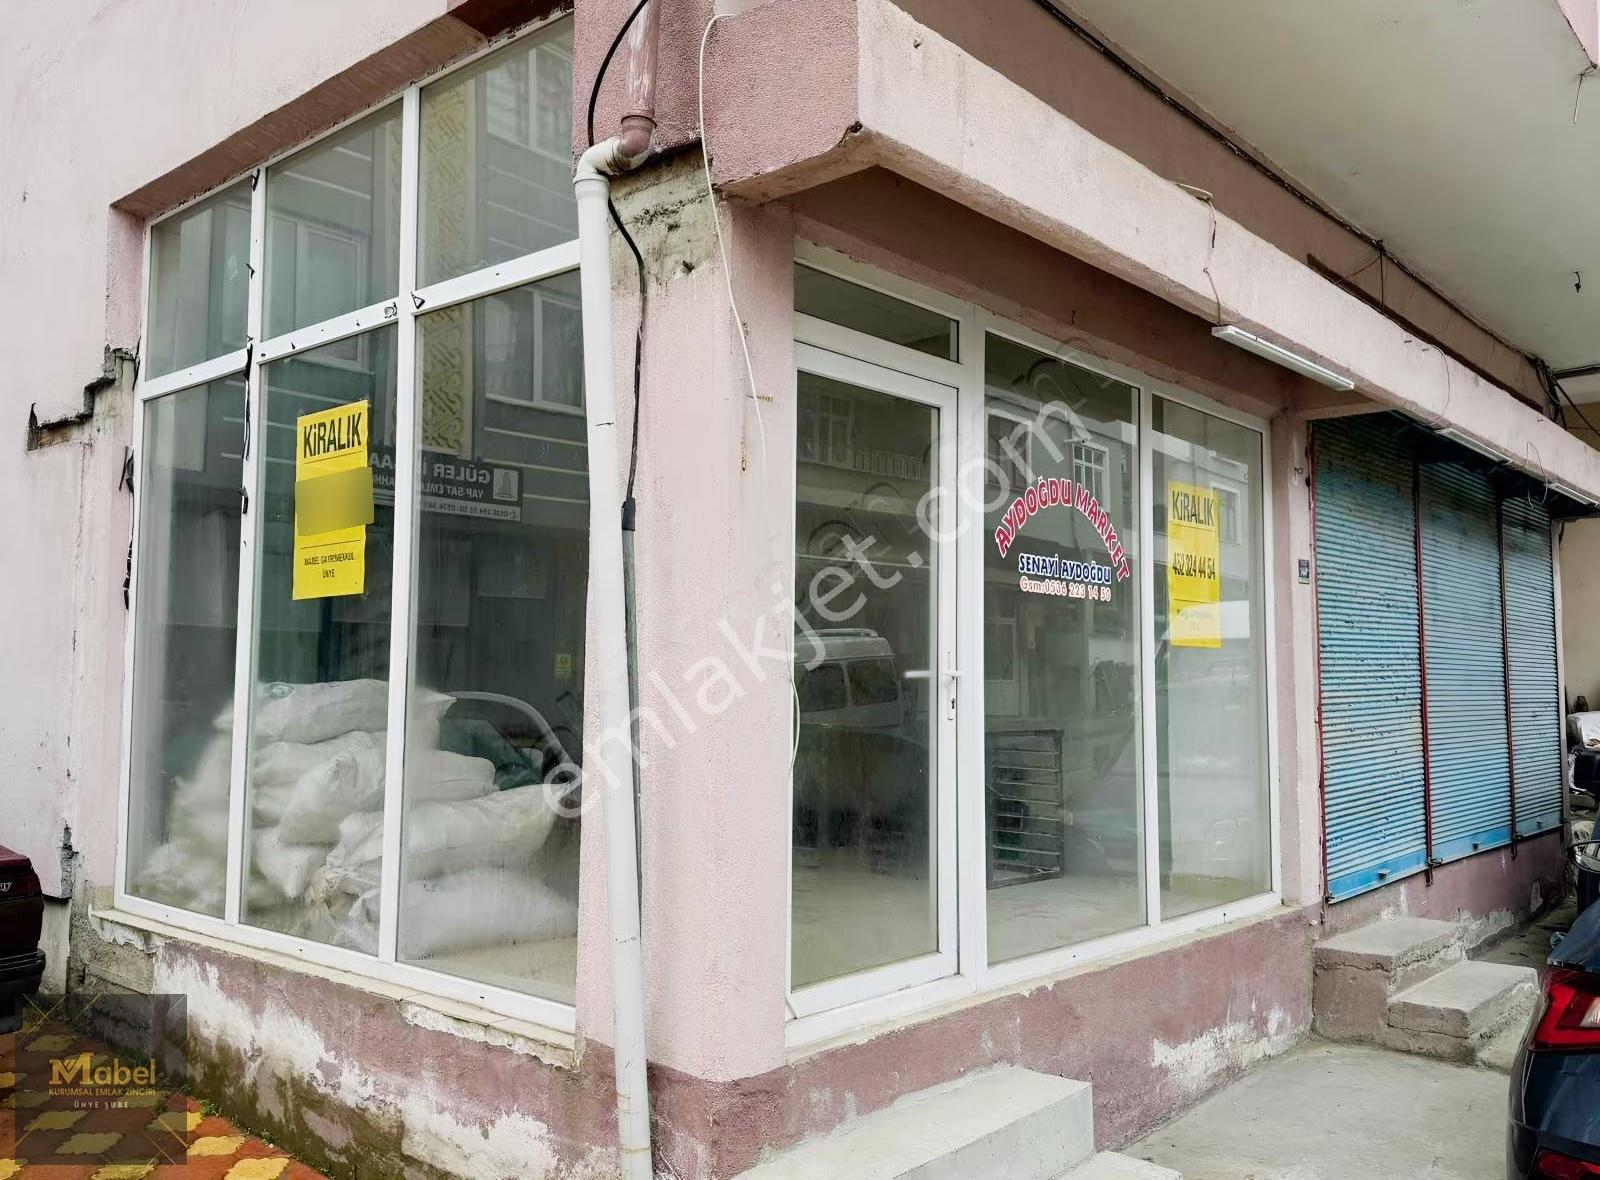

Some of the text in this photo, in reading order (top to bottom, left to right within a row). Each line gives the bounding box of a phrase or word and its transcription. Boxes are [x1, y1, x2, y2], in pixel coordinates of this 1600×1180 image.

[995, 475, 1072, 559] AYDOĞDU
[1074, 483, 1129, 582] MARKET
[1019, 553, 1111, 584] SENAYİ AYDOĞDU
